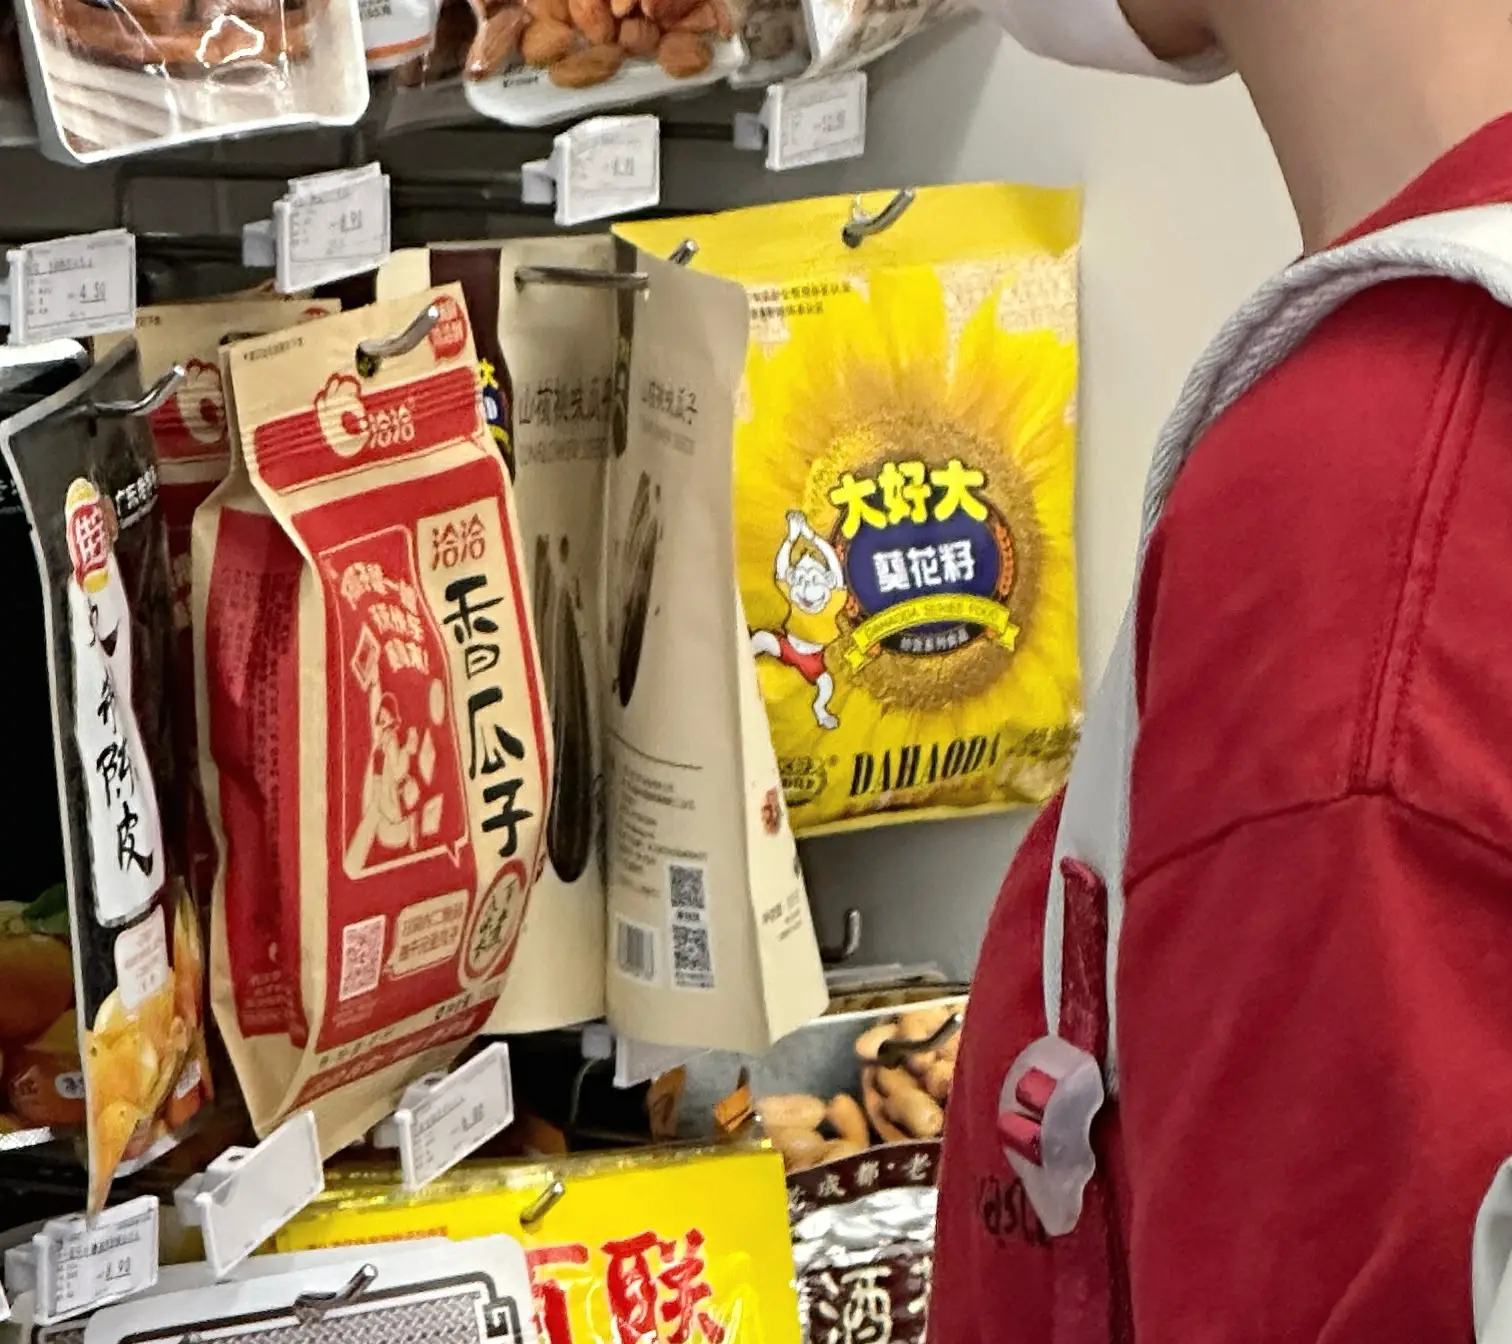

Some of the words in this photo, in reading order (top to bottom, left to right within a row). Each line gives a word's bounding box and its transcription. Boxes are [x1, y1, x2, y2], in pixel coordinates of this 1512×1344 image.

[830, 459, 988, 539] 大好大
[431, 517, 486, 571] 洽洽
[442, 574, 535, 857] 香瓜子
